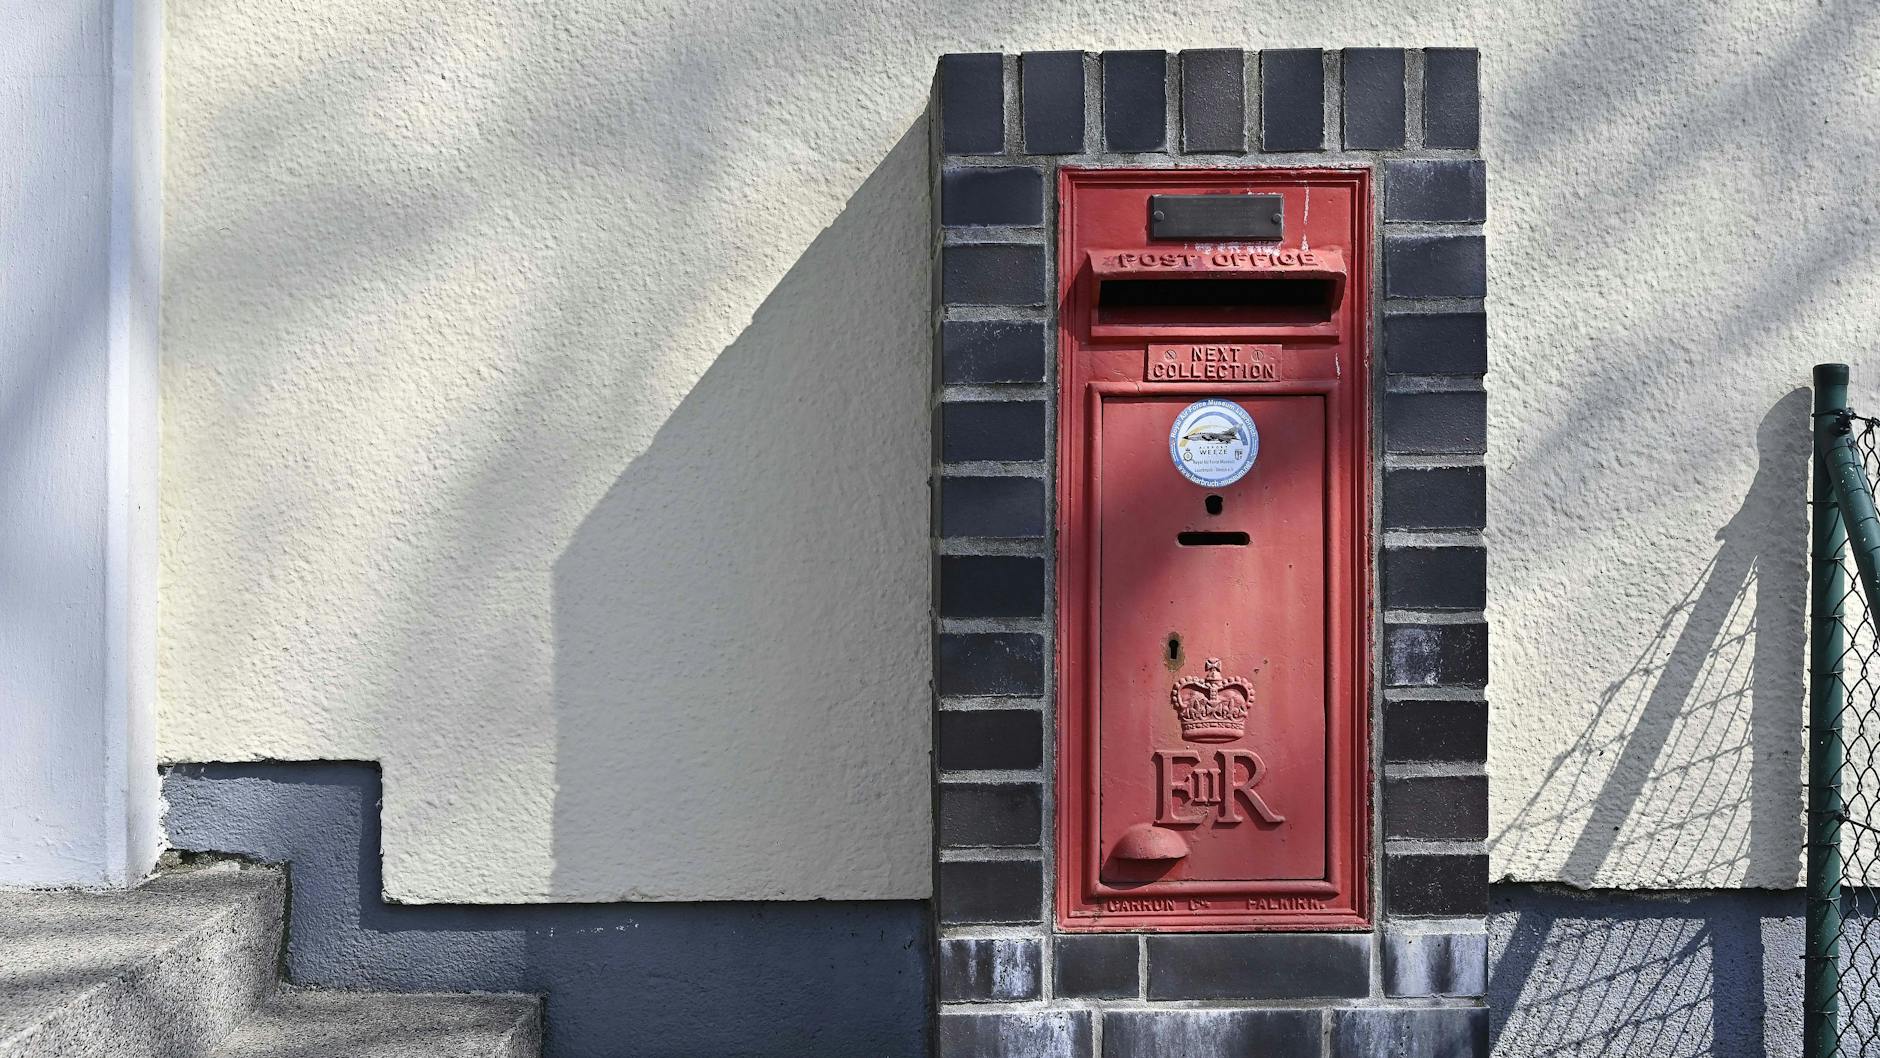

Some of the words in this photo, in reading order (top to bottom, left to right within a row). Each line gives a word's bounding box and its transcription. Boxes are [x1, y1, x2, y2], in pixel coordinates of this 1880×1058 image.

[1118, 252, 1196, 268] POST
[1212, 251, 1318, 267] OFFICE
[1191, 346, 1241, 363] NEXT
[1153, 362, 1276, 380] COLLECTION
[1171, 419, 1181, 438] Royal
[1189, 402, 1207, 412] Force
[1208, 400, 1235, 410] Museum
[1107, 899, 1176, 913] CARRON
